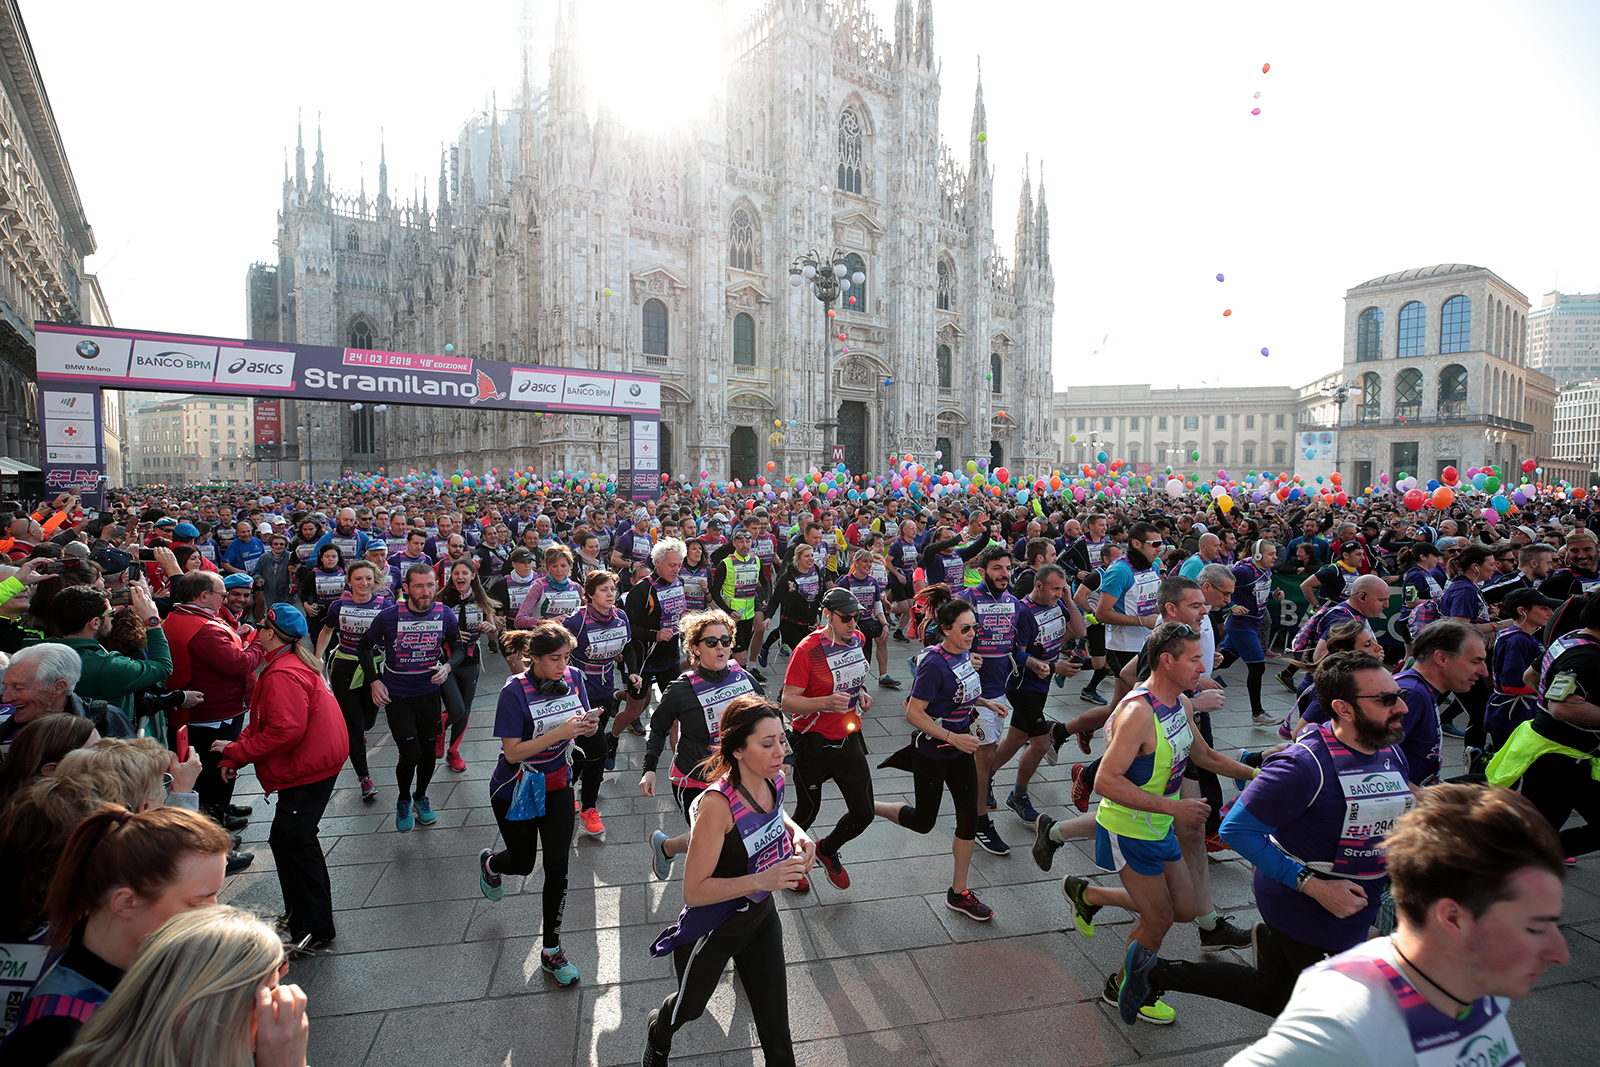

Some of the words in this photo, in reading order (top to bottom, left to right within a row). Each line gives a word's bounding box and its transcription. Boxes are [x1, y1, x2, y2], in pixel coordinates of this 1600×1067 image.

[64, 363, 86, 371] BMW
[86, 365, 112, 373] Milano
[136, 356, 184, 368] BANCO
[186, 360, 211, 370] BPM
[349, 352, 362, 362] 24
[369, 354, 382, 363] 03
[389, 355, 412, 366] 2019
[433, 361, 468, 371] EDIZIONE
[304, 367, 478, 398] Stramilano
[566, 387, 595, 396] BANCO
[595, 388, 611, 397] BPM
[832, 448, 844, 460] M
[833, 655, 855, 667] BANCO
[705, 691, 732, 704] BANCO
[731, 685, 748, 695] BPM
[536, 704, 561, 717] BANCO
[561, 700, 576, 710] BPM
[1349, 782, 1385, 795] BANCO
[1385, 780, 1402, 792] BPM
[1373, 819, 1396, 835] 294
[753, 824, 783, 851] BANCO
